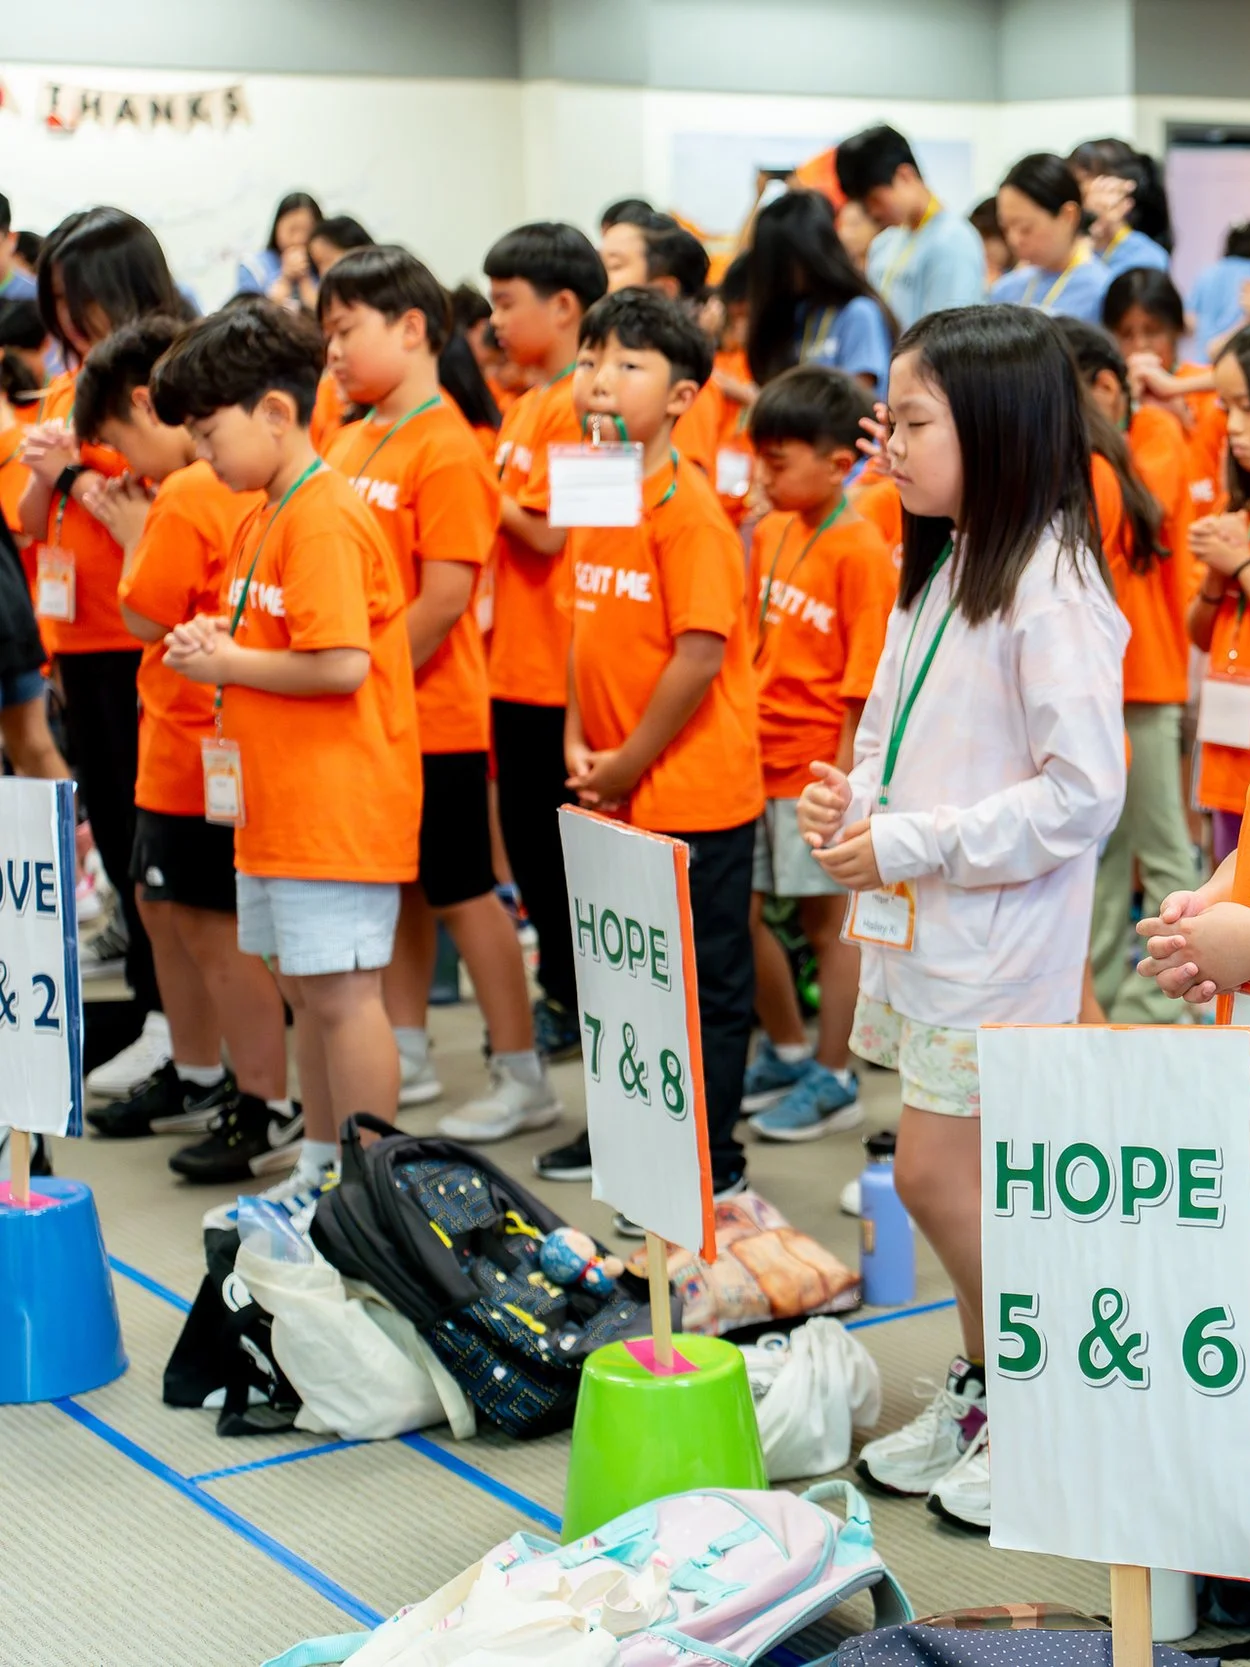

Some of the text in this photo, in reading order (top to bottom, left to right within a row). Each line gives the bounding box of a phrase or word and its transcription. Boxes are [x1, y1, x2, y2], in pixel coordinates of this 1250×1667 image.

[615, 568, 653, 602] ME
[0, 860, 57, 914] VE
[575, 897, 670, 987] HOPE
[32, 974, 60, 1031] 2
[584, 1012, 686, 1115] 7 & 8
[994, 1140, 1223, 1226] HOPE
[998, 1287, 1241, 1391] 5 & 6
